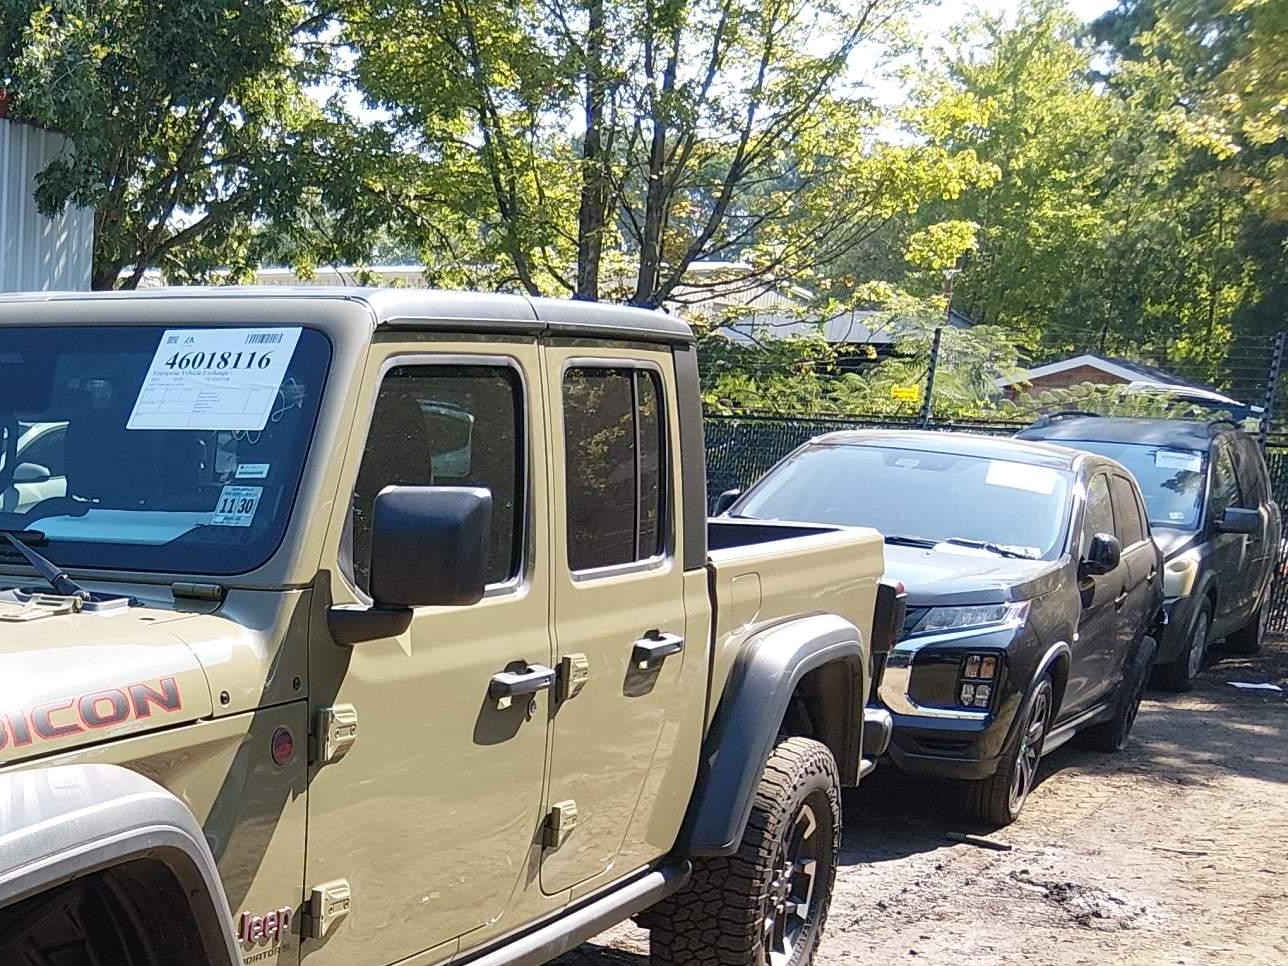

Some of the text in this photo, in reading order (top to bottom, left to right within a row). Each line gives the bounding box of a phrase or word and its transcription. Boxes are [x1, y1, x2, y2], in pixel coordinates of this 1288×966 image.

[165, 350, 275, 370] 46018116
[219, 497, 254, 514] 11 30
[236, 905, 294, 945] Jeep
